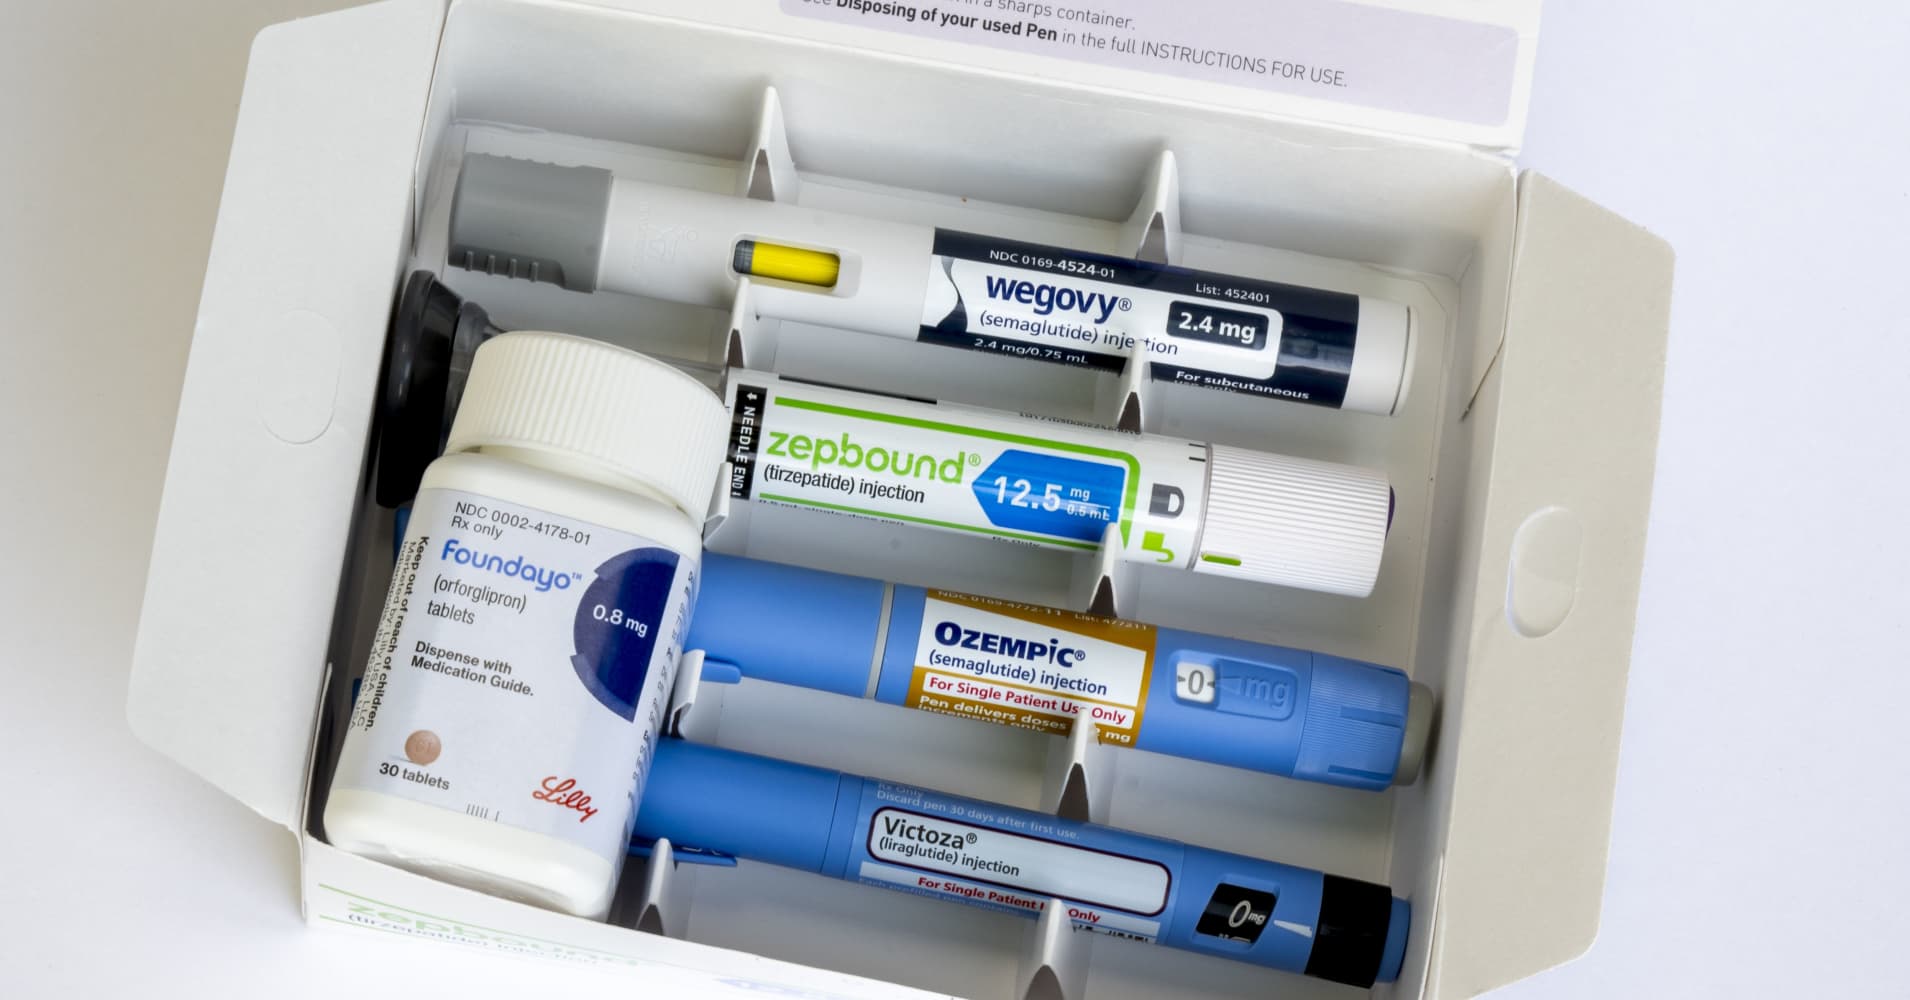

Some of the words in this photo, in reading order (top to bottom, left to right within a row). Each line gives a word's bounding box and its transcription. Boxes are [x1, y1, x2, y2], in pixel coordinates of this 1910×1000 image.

[998, 0, 1053, 18] sharps
[1057, 7, 1136, 30] container.
[836, 0, 916, 22] Disposing
[921, 6, 939, 22] of
[940, 12, 979, 28] your
[982, 16, 1022, 35] used
[1026, 22, 1057, 41] Pen
[1062, 29, 1075, 44] in
[1081, 32, 1106, 49] the
[1111, 36, 1136, 54] full
[1141, 41, 1266, 74] INSTRUCTIONS
[1272, 61, 1306, 80] FOR
[1310, 67, 1348, 87] USE.
[989, 250, 1019, 262] NDC
[1021, 255, 1115, 279] 0169-4524-01
[1196, 283, 1221, 296] List:
[1224, 288, 1270, 303] 452401
[980, 310, 1099, 344] (semaglutide)
[1104, 329, 1178, 356] injetion
[1178, 311, 1213, 334] 2.4
[1219, 322, 1256, 344] mg
[974, 338, 998, 350] 2.4
[1002, 342, 1062, 360] mg/0.75
[1067, 355, 1089, 364] mL
[1176, 371, 1201, 382] For
[1204, 375, 1310, 400] subcutaneous
[736, 406, 756, 464] NEEDLE
[732, 467, 746, 489] END
[764, 464, 855, 494] (tirzepatide)
[859, 478, 925, 503] injection
[994, 476, 1063, 512] 12.5
[1070, 487, 1090, 501] mg
[451, 515, 471, 530] Rx
[474, 521, 503, 541] only
[456, 502, 488, 518] NDC
[491, 509, 590, 546] 0002-4178-01
[1067, 505, 1087, 516] 0.5
[1090, 509, 1110, 521] mL
[412, 536, 430, 571] Keep
[406, 574, 416, 596] out
[433, 574, 527, 614] (orforglipron)
[400, 598, 409, 612] of
[427, 601, 475, 625] tablets
[592, 604, 623, 625] 0.8
[625, 616, 648, 638] mg
[387, 615, 404, 654] reach
[382, 656, 392, 671] of
[415, 640, 480, 670] Dispense
[483, 656, 513, 675] with
[929, 649, 1036, 684] (semaglutide)
[1040, 670, 1107, 696] injection
[410, 655, 487, 686] Medication
[490, 674, 534, 697] Guide.
[1188, 669, 1204, 695] 0
[364, 672, 388, 732] children.
[929, 677, 953, 691] For
[957, 682, 1001, 700] Single
[1005, 691, 1057, 710] Patient
[1061, 702, 1087, 714] Us
[1091, 707, 1126, 725] Only
[919, 695, 949, 709] Pen
[954, 702, 1017, 721] delivers
[1021, 714, 1066, 730] doses
[1106, 731, 1131, 743] mg
[379, 762, 399, 778] 30
[402, 767, 450, 791] tablets
[532, 776, 598, 824] Lilly
[877, 790, 920, 807] Discard
[924, 801, 946, 814] pen
[950, 805, 964, 816] 30
[967, 808, 994, 825] days
[997, 814, 1026, 829] after
[1030, 820, 1053, 834] first
[1056, 828, 1080, 840] use.
[879, 836, 958, 865] (liraglutide)
[961, 853, 1020, 877] injection
[918, 877, 942, 890] For
[943, 882, 985, 901] Single
[988, 891, 1038, 910] Patient
[1068, 908, 1100, 923] Only
